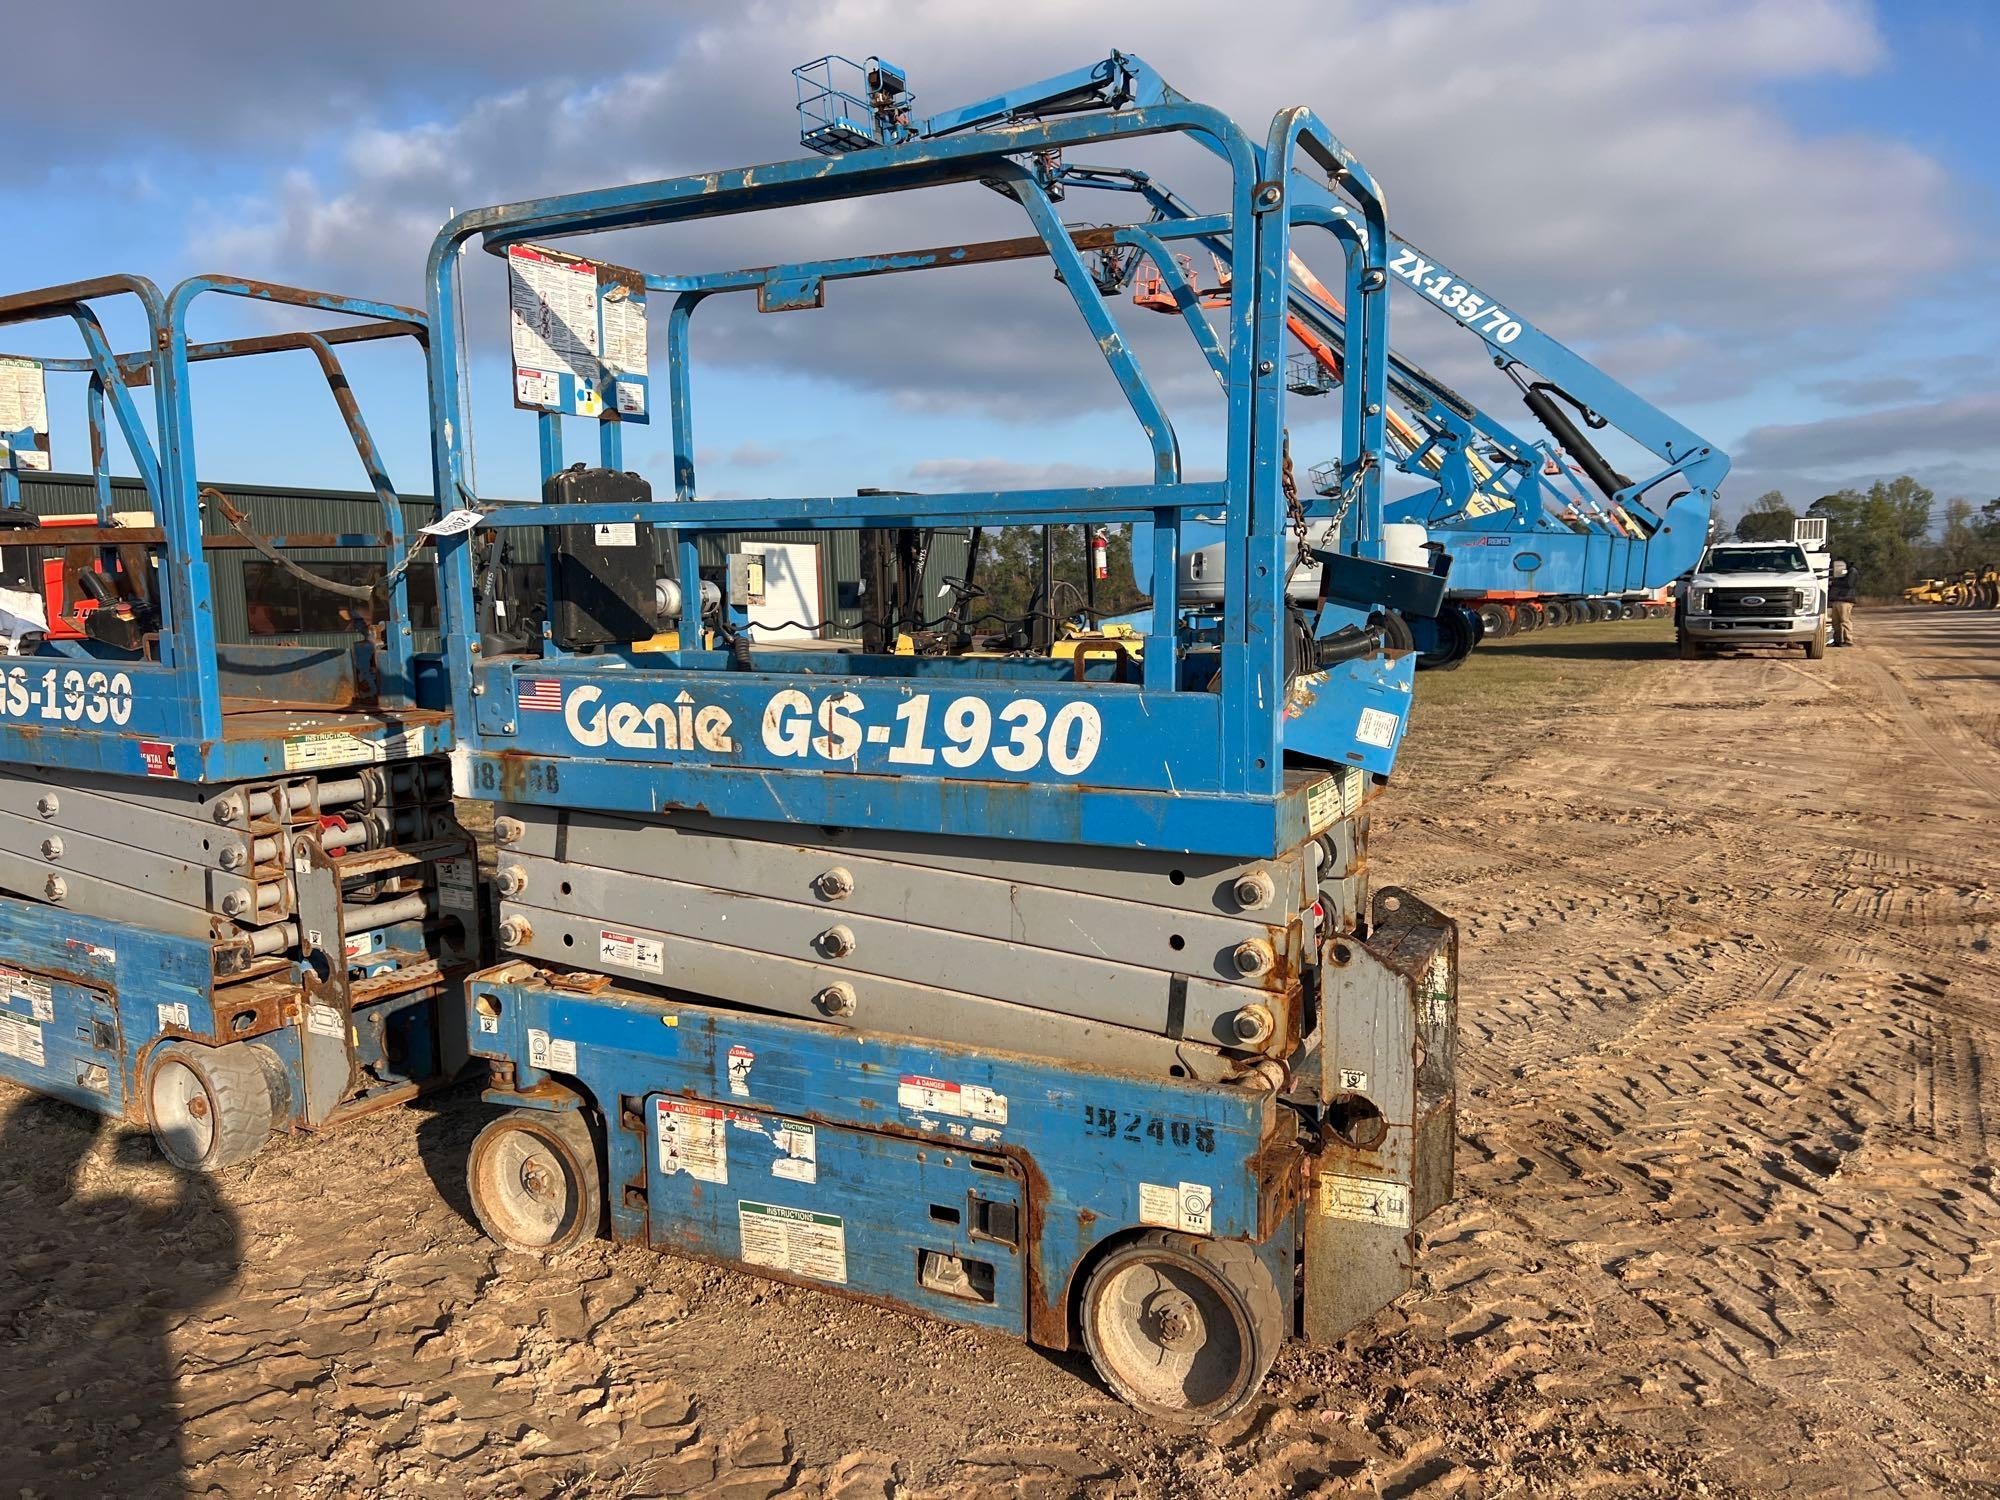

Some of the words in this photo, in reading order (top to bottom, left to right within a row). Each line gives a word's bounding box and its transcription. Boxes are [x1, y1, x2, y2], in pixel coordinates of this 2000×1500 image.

[1389, 248, 1522, 344] ZX-135/70
[1473, 500, 1491, 514] JLG
[565, 685, 733, 752] Genie
[761, 689, 1102, 776] GS-1930
[921, 1079, 946, 1090] DANGER
[679, 1106, 707, 1116] DANGER
[766, 1206, 814, 1222] INSTRUCTIONS
